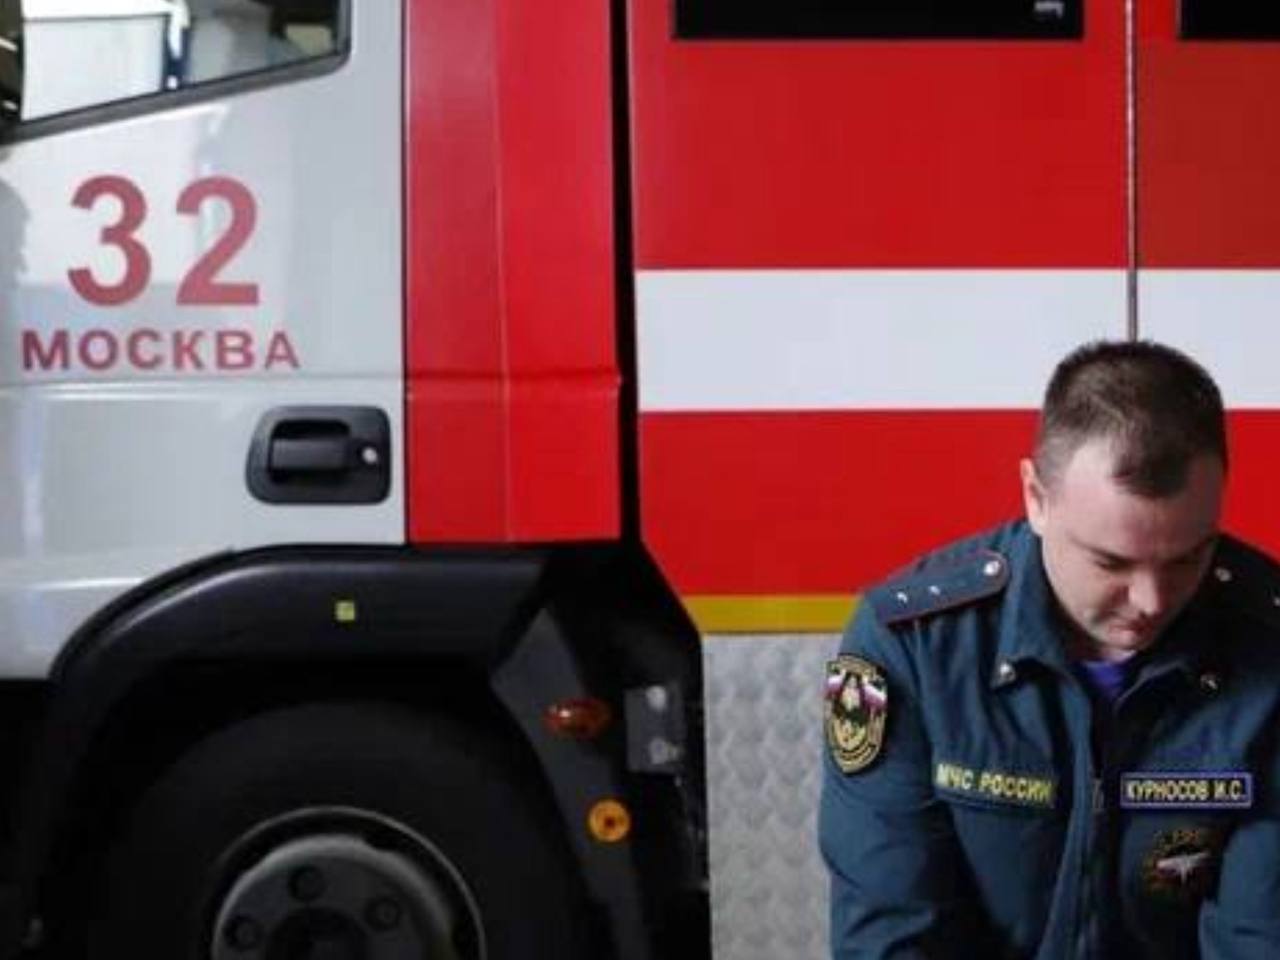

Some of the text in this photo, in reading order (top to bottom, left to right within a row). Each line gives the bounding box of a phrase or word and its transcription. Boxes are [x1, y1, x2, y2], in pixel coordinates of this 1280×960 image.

[67, 175, 260, 307] 32
[20, 328, 301, 372] МОСКВА
[936, 762, 1053, 802] МЧС РОССИИ
[1126, 779, 1209, 801] КУРНОСОВ
